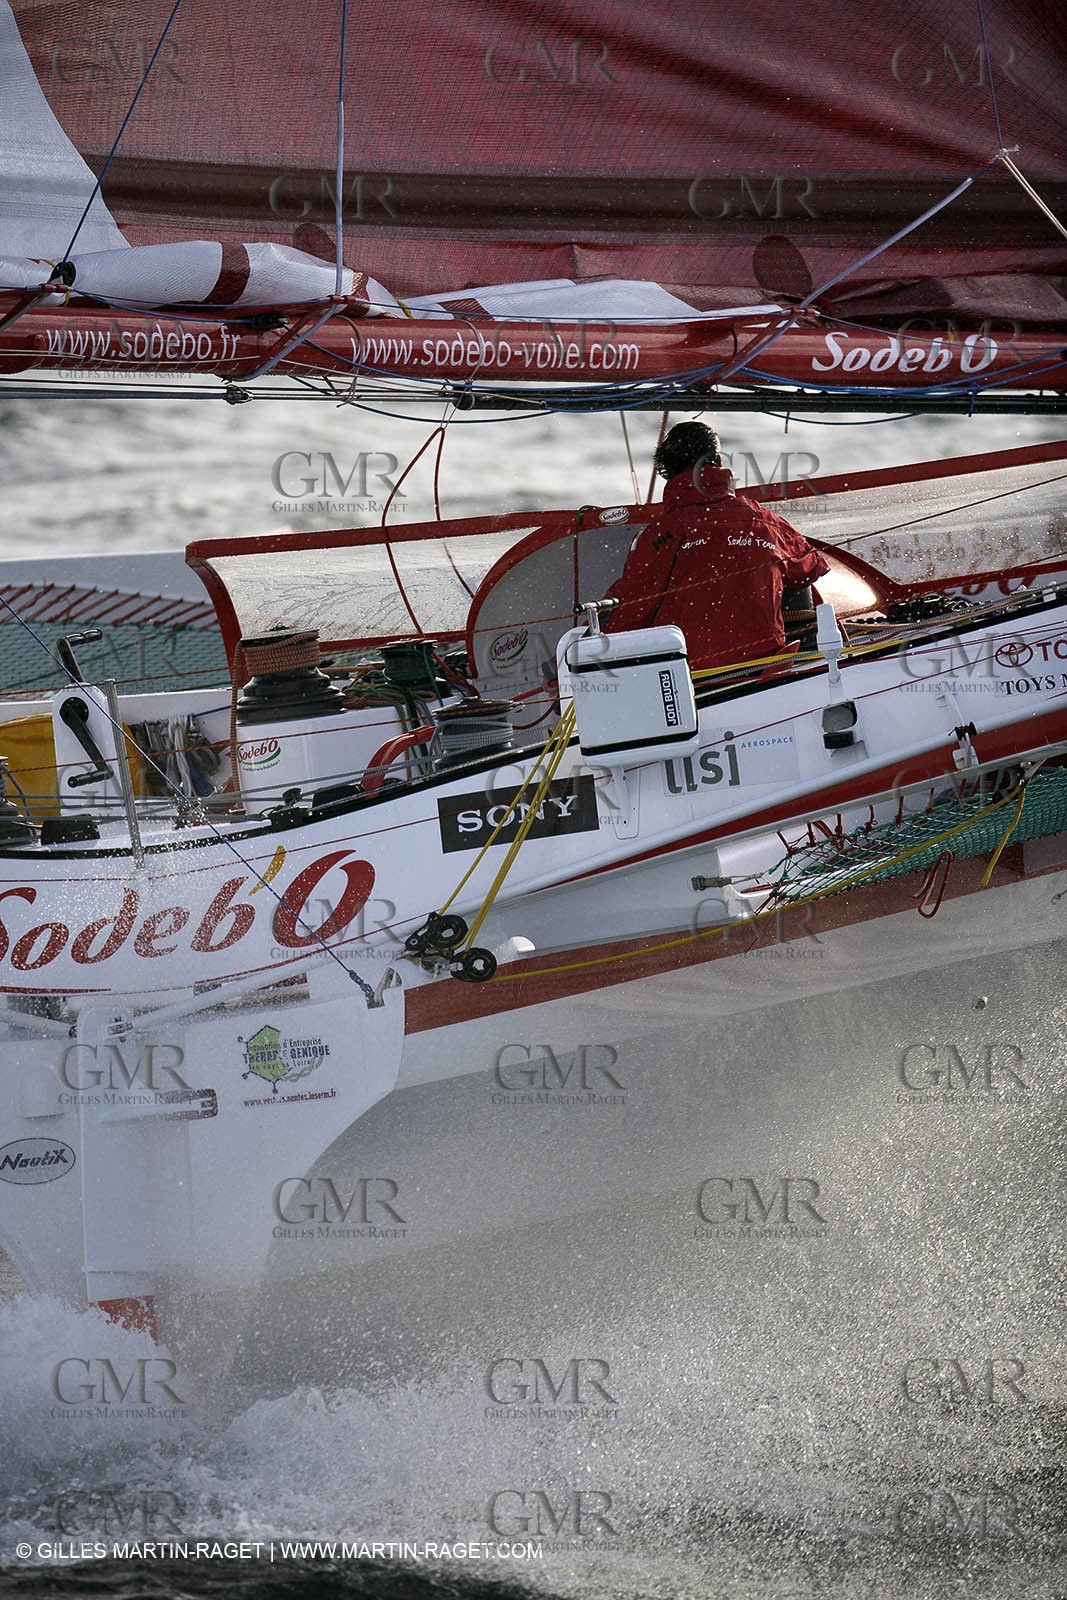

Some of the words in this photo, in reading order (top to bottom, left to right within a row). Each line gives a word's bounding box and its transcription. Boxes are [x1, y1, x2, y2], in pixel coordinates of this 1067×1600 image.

[47, 324, 240, 360] www.sodebo.fr
[350, 331, 640, 369] www.sodebo-voile.com
[660, 672, 674, 702] BUOY
[1001, 675, 1056, 695] TOYS
[666, 704, 677, 725] JON
[741, 736, 793, 749] AEROSPACE
[456, 794, 578, 833] SONY
[290, 1044, 330, 1060] GENIQUE
